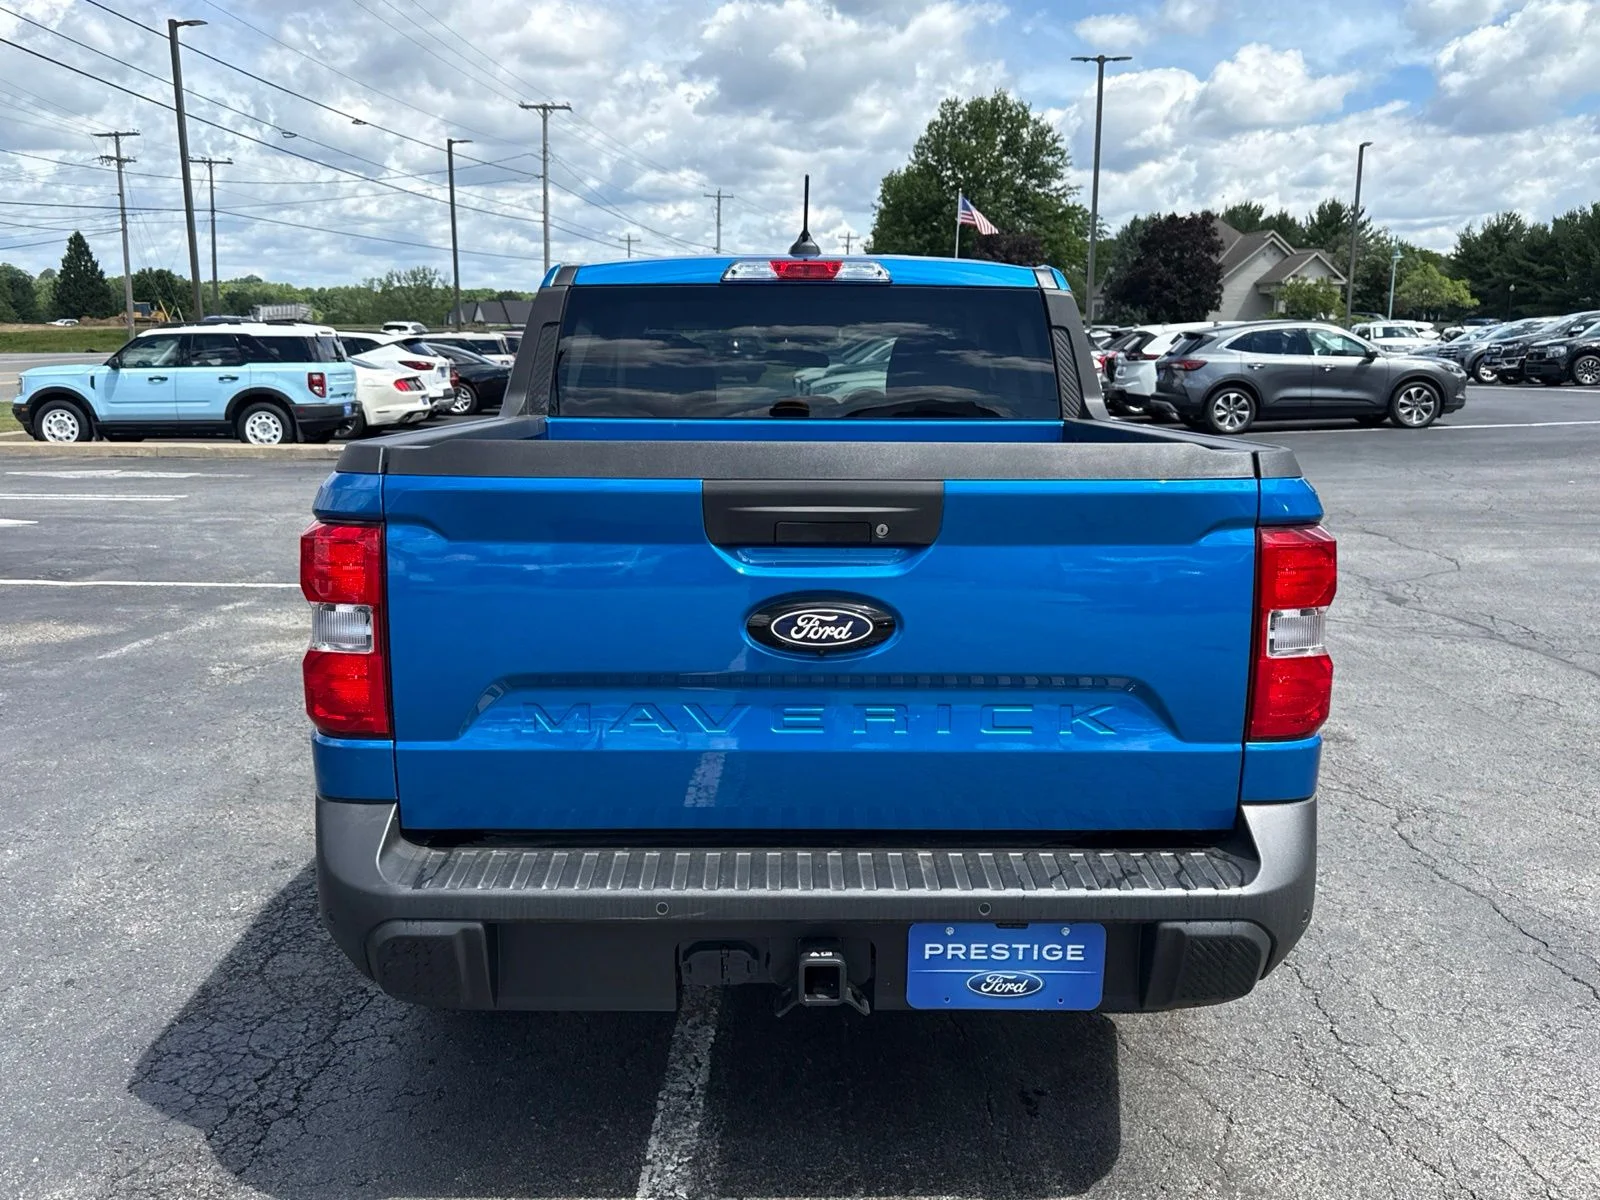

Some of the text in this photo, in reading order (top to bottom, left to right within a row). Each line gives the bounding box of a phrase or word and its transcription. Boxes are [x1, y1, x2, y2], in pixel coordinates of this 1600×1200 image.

[790, 613, 854, 640] Ford
[521, 702, 1117, 735] MAVERICK
[923, 943, 1086, 961] PRESTIGE
[980, 973, 1029, 993] Ford
